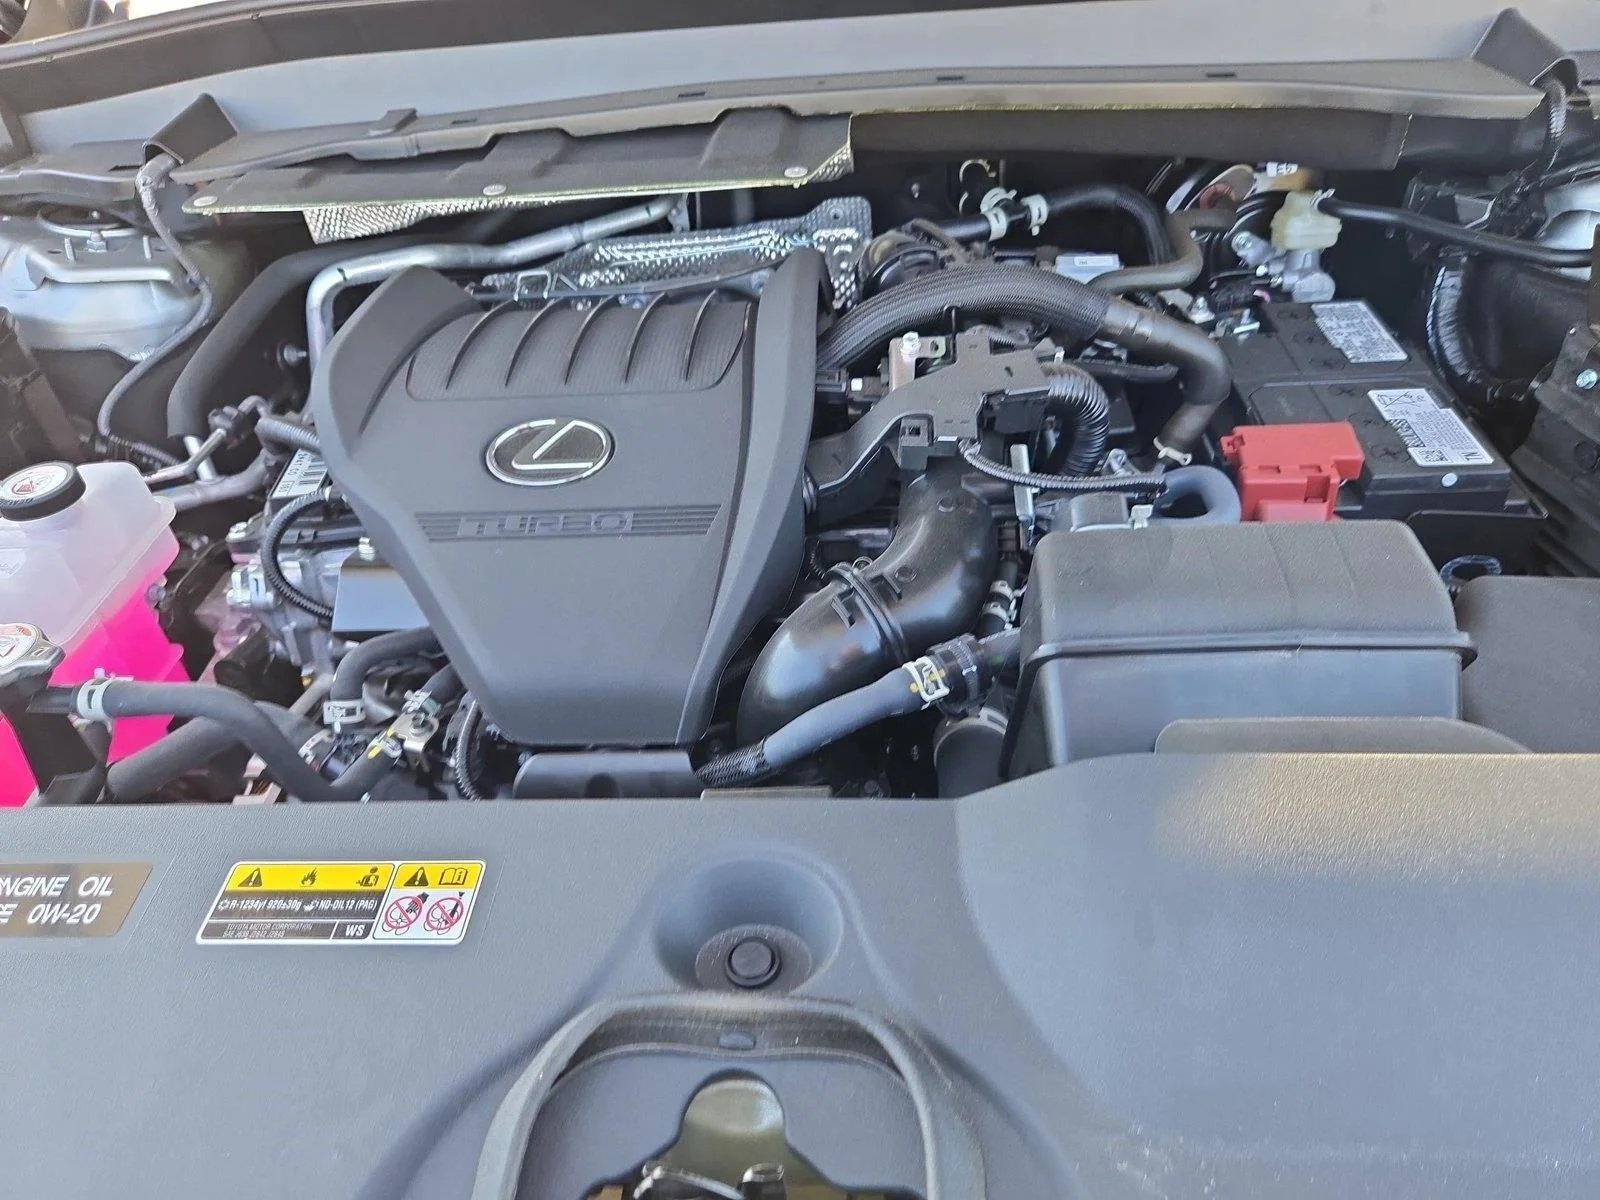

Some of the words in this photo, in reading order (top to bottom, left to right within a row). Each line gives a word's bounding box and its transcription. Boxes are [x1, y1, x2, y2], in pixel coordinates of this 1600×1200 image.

[457, 511, 633, 537] TURBO
[0, 876, 70, 896] NGINE
[78, 875, 113, 897] OIL
[27, 903, 102, 924] 0W-20
[355, 899, 378, 911] (PAG)
[345, 924, 367, 937] WS
